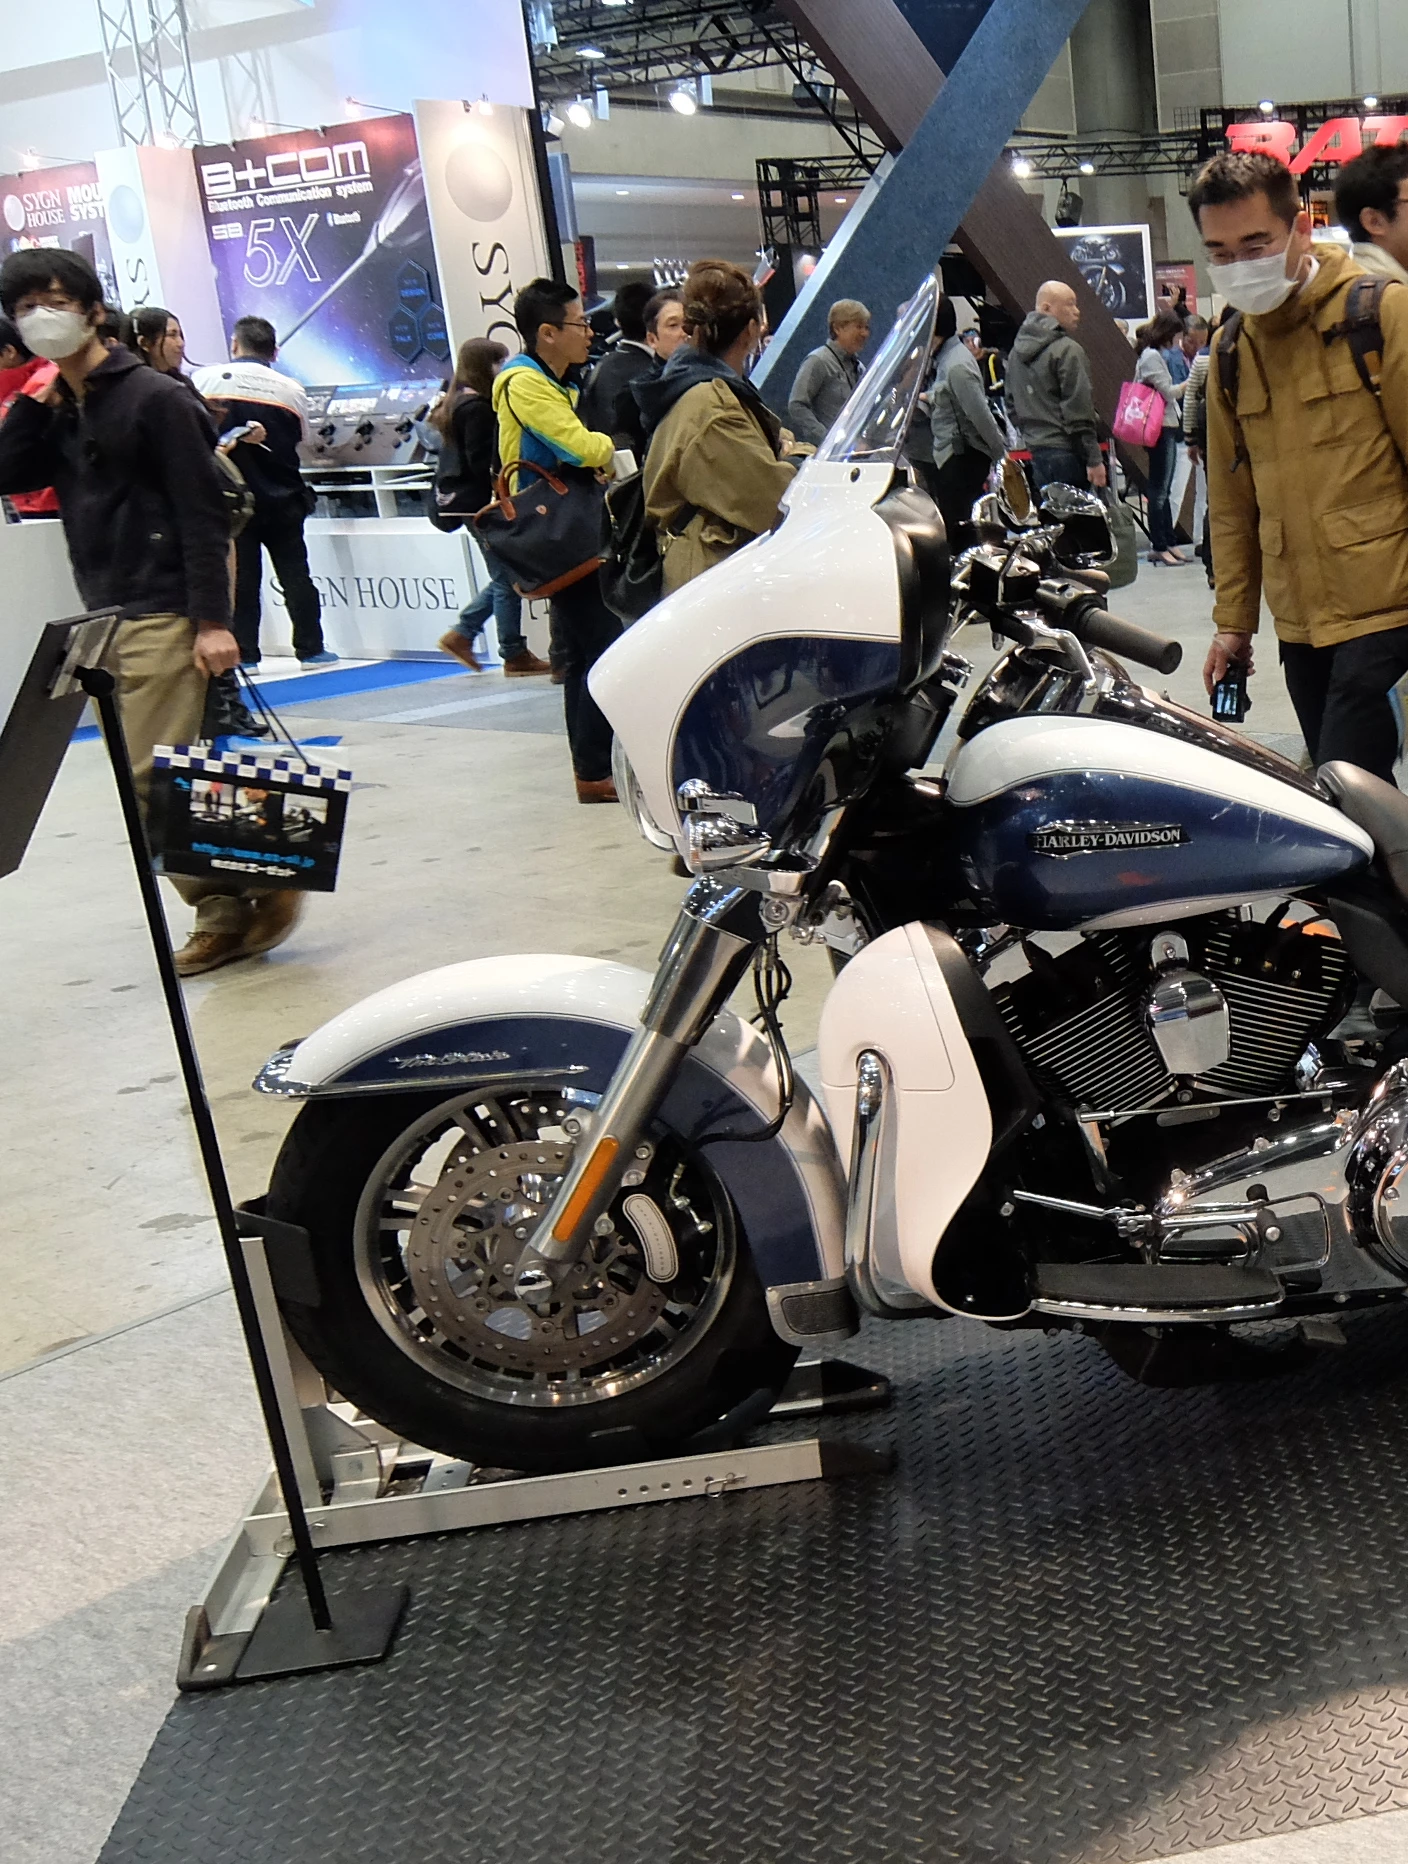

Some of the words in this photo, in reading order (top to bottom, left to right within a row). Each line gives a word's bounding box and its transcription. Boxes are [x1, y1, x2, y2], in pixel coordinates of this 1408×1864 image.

[201, 142, 371, 196] B+COM
[23, 189, 61, 212] SYGN
[256, 185, 332, 207] Communication
[336, 181, 373, 199] system
[27, 209, 65, 228] HOUSE
[244, 213, 322, 287] 5X
[270, 576, 347, 606] SGN
[355, 576, 459, 610] HOUSE
[1034, 828, 1181, 849] HARLEY-DAVIDSON
